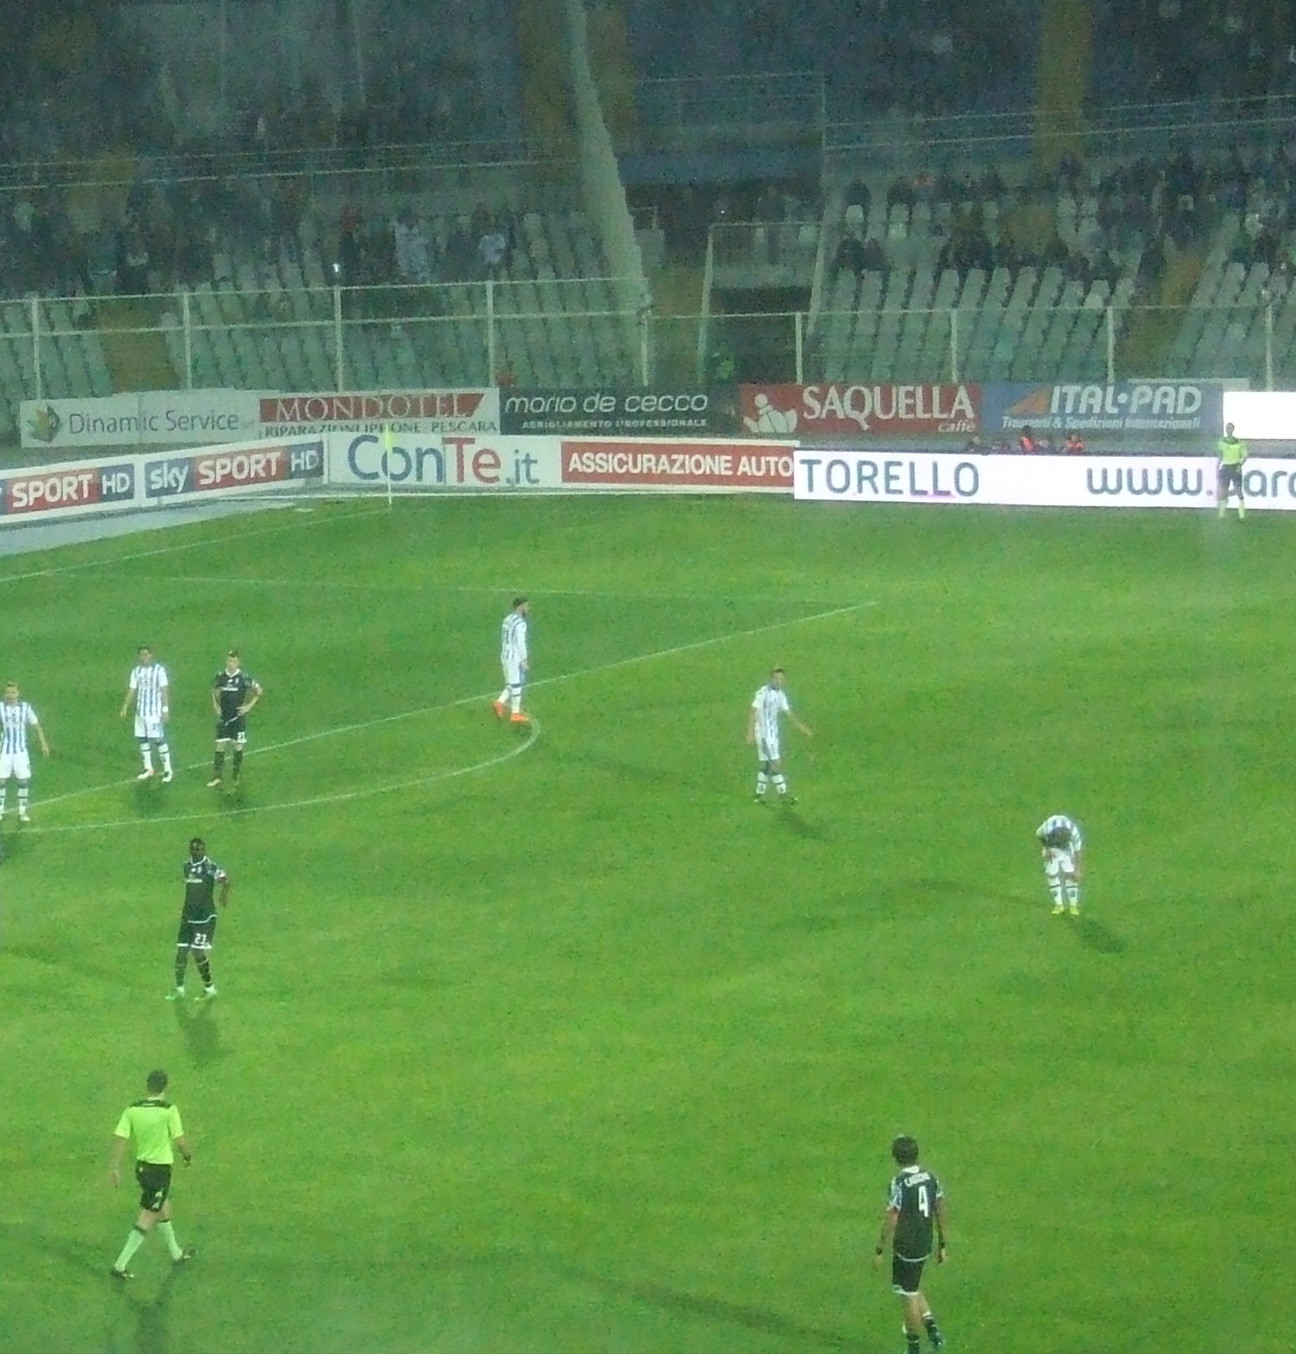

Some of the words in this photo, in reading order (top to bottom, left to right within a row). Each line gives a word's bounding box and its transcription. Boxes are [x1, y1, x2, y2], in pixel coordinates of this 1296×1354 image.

[275, 394, 467, 421] MONDOTEL
[505, 396, 576, 413] mario
[583, 393, 616, 413] de
[624, 394, 708, 412] cecco
[802, 385, 975, 430] SAQUELLA
[69, 409, 159, 435] Dinamic
[165, 408, 239, 432] Service
[149, 463, 189, 493] sky
[199, 451, 282, 487] SPORT
[290, 450, 320, 473] HD
[347, 434, 541, 485] ConTe.it
[568, 452, 733, 476] ASSICURAZIONE
[738, 455, 793, 477] AUTO
[12, 473, 93, 509] SPORT
[101, 472, 130, 497] HD
[800, 459, 980, 496] TORELLO
[918, 1185, 930, 1218] 4
